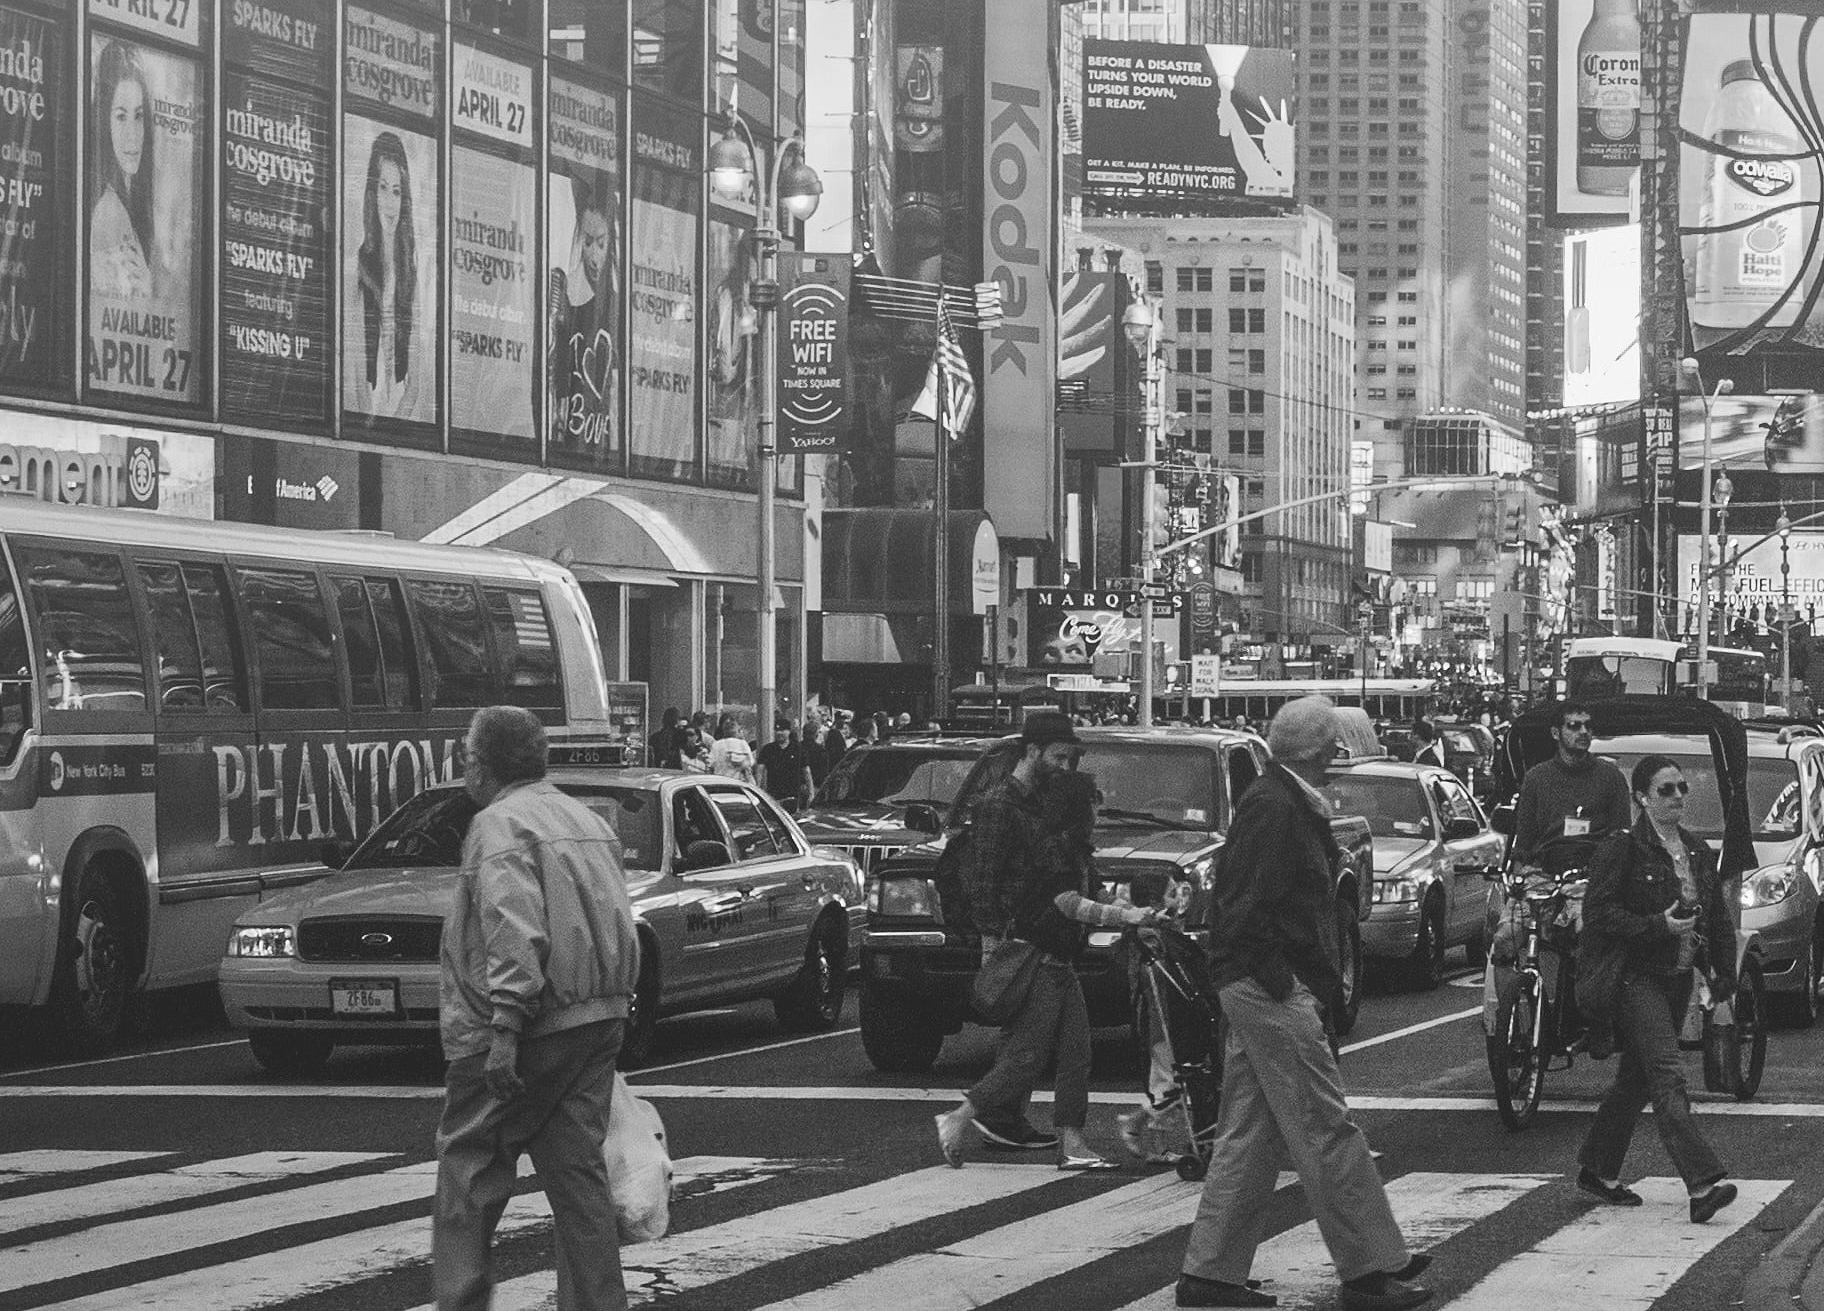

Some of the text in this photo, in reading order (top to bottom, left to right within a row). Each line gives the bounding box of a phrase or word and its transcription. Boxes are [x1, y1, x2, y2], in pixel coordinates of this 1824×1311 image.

[294, 18, 318, 50] FLY
[348, 15, 432, 69] miranda
[1087, 55, 1203, 73] BEFORE A DISASTER
[1583, 54, 1640, 78] Coron
[348, 55, 432, 105] cosgrove
[1087, 69, 1213, 87] TURNS YOUR WORLD
[1597, 73, 1640, 86] Extra
[1087, 83, 1178, 100] UPSIDE DOWN,
[457, 86, 526, 134] APRIL 27
[1087, 97, 1147, 110] BE READY.
[226, 99, 313, 153] miranda
[226, 140, 316, 186] cosgrove
[1147, 170, 1236, 190] READYNYC.ORG
[989, 81, 1040, 379] Kodak
[1743, 265, 1782, 277] Hope
[100, 306, 177, 340] AVAILABLE
[789, 319, 837, 341] FREE
[792, 343, 833, 364] WIFI
[162, 347, 193, 393] 27
[783, 378, 841, 390] TIMES SQUARE
[791, 435, 836, 449] YAHOO!
[66, 764, 81, 778] New
[83, 763, 98, 778] York
[99, 763, 112, 780] City
[113, 763, 126, 778] Bus
